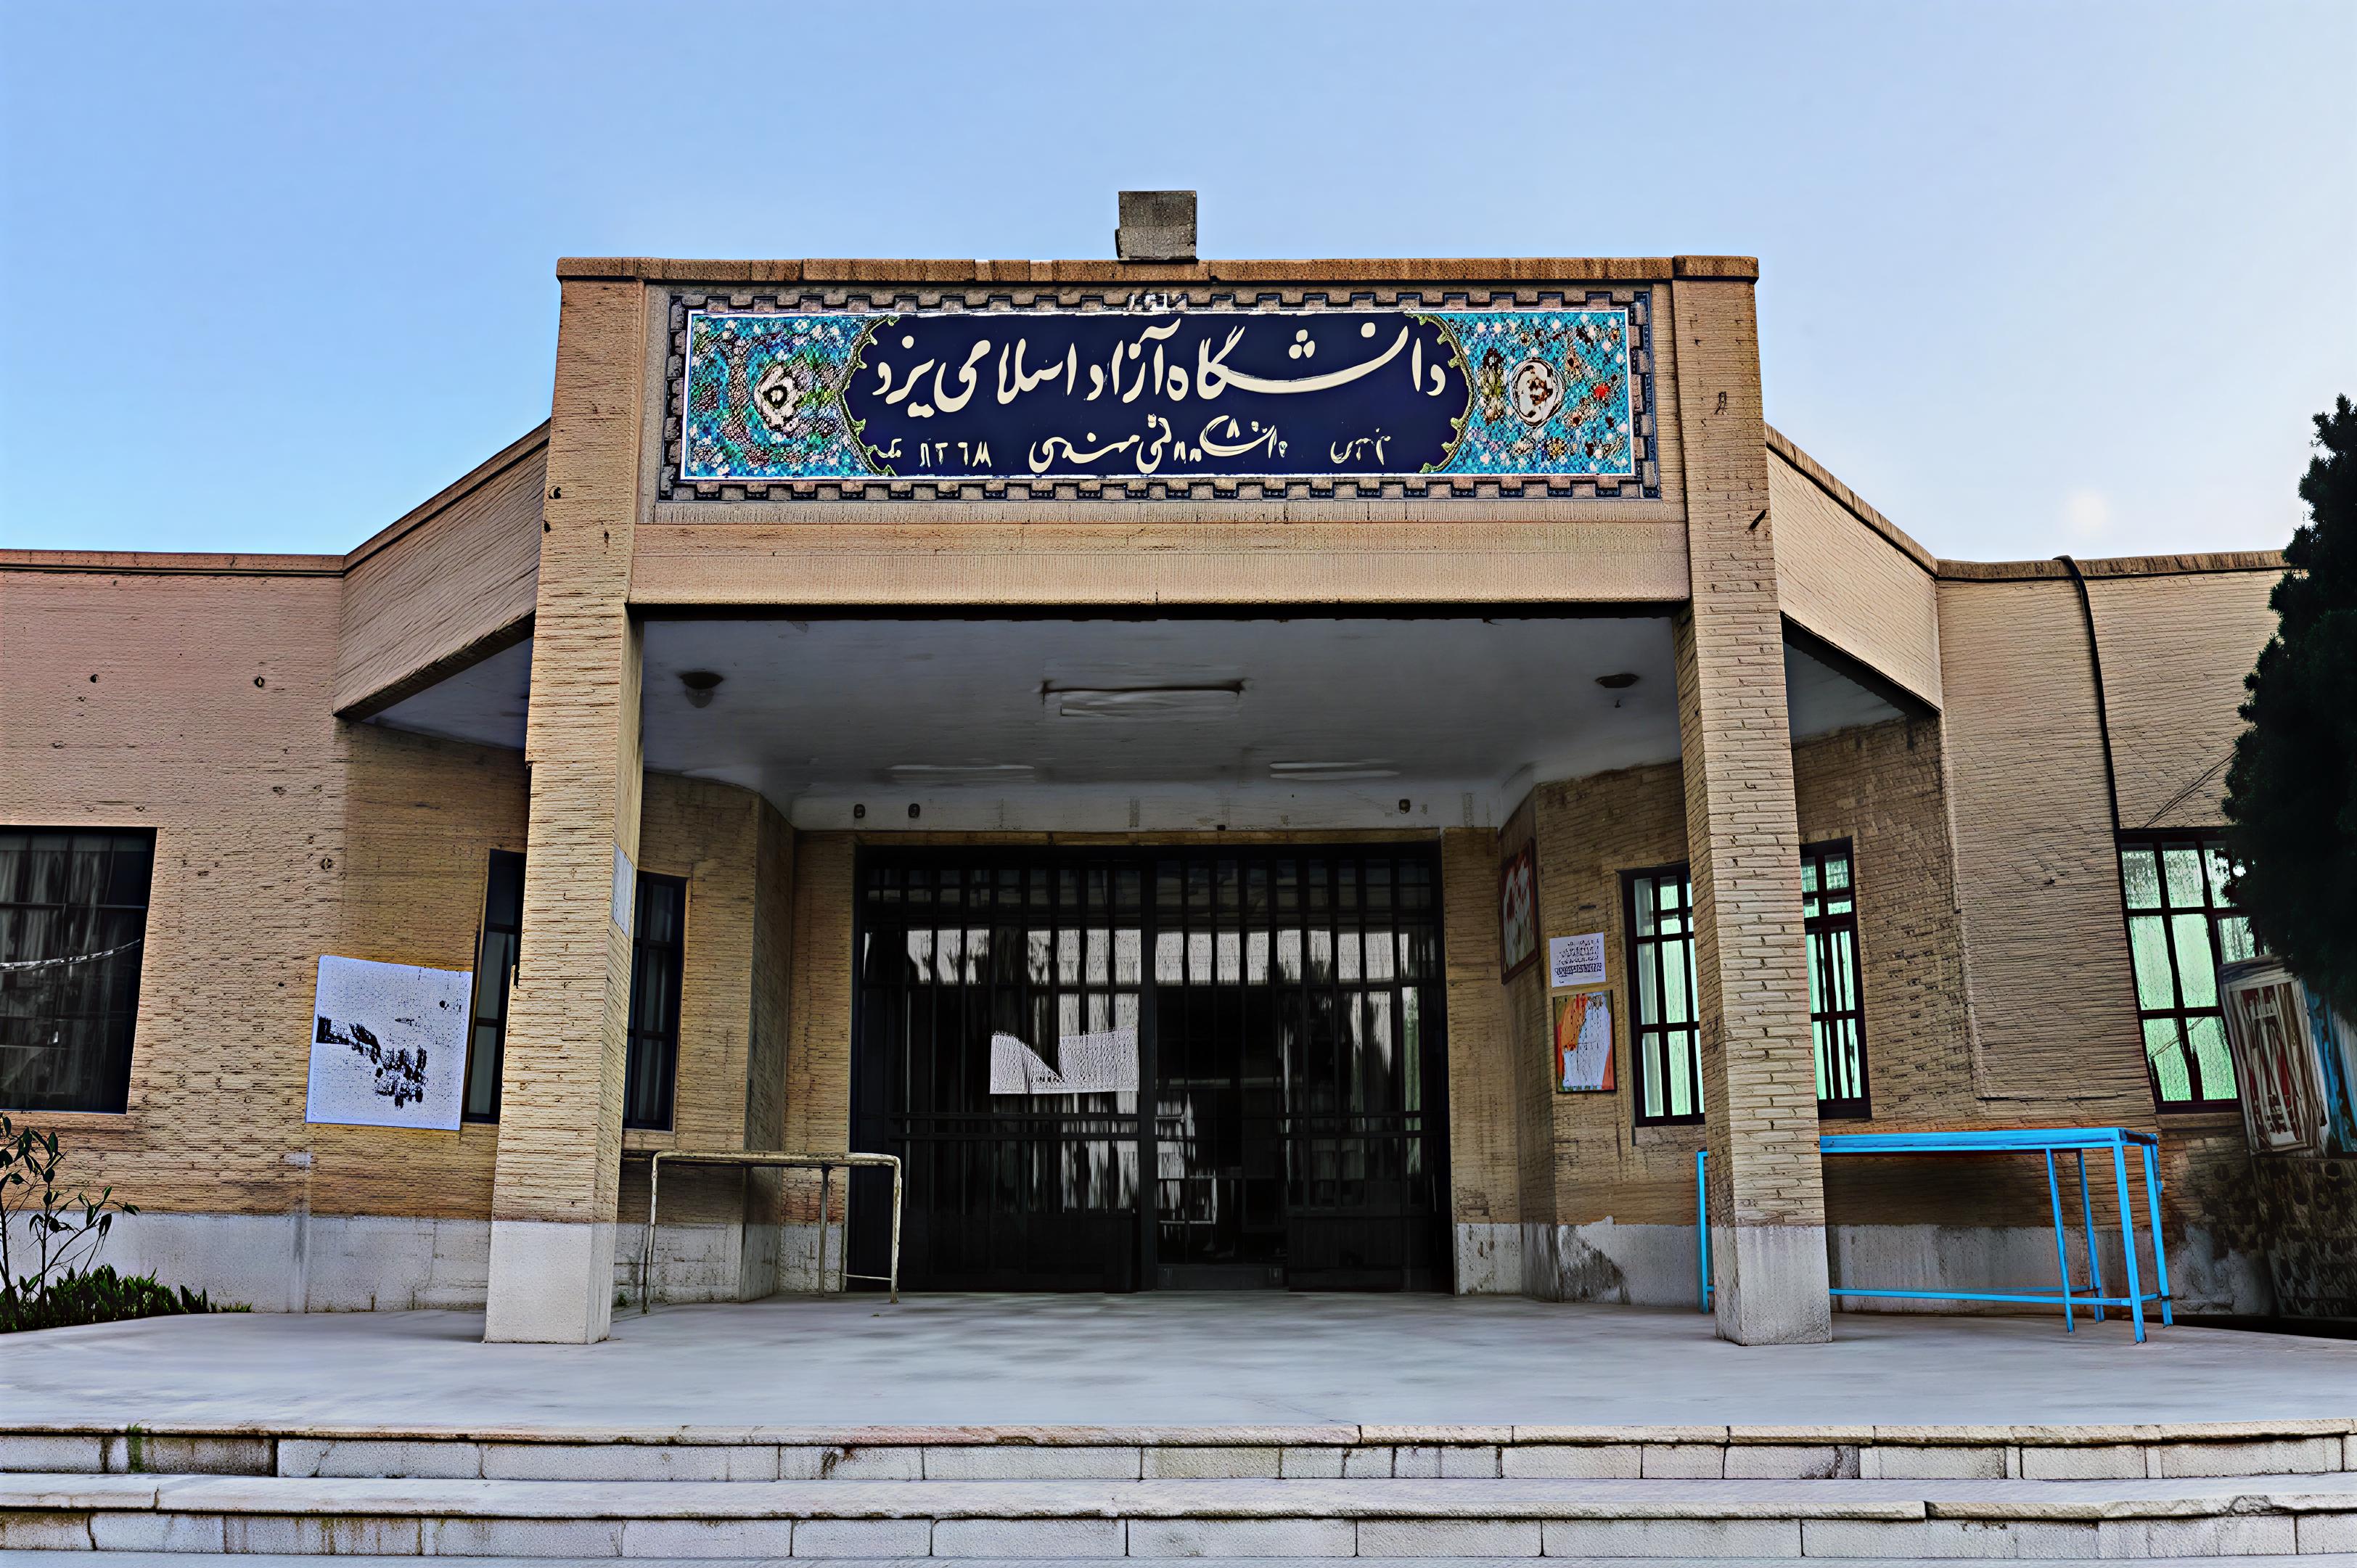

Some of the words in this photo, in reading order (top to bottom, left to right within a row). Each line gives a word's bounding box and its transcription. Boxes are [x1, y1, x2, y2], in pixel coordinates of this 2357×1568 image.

[872, 335, 934, 418] یزد
[934, 338, 1077, 413] اسلامی
[1086, 318, 1181, 403] آزاد
[1167, 326, 1446, 401] دانشگاه
